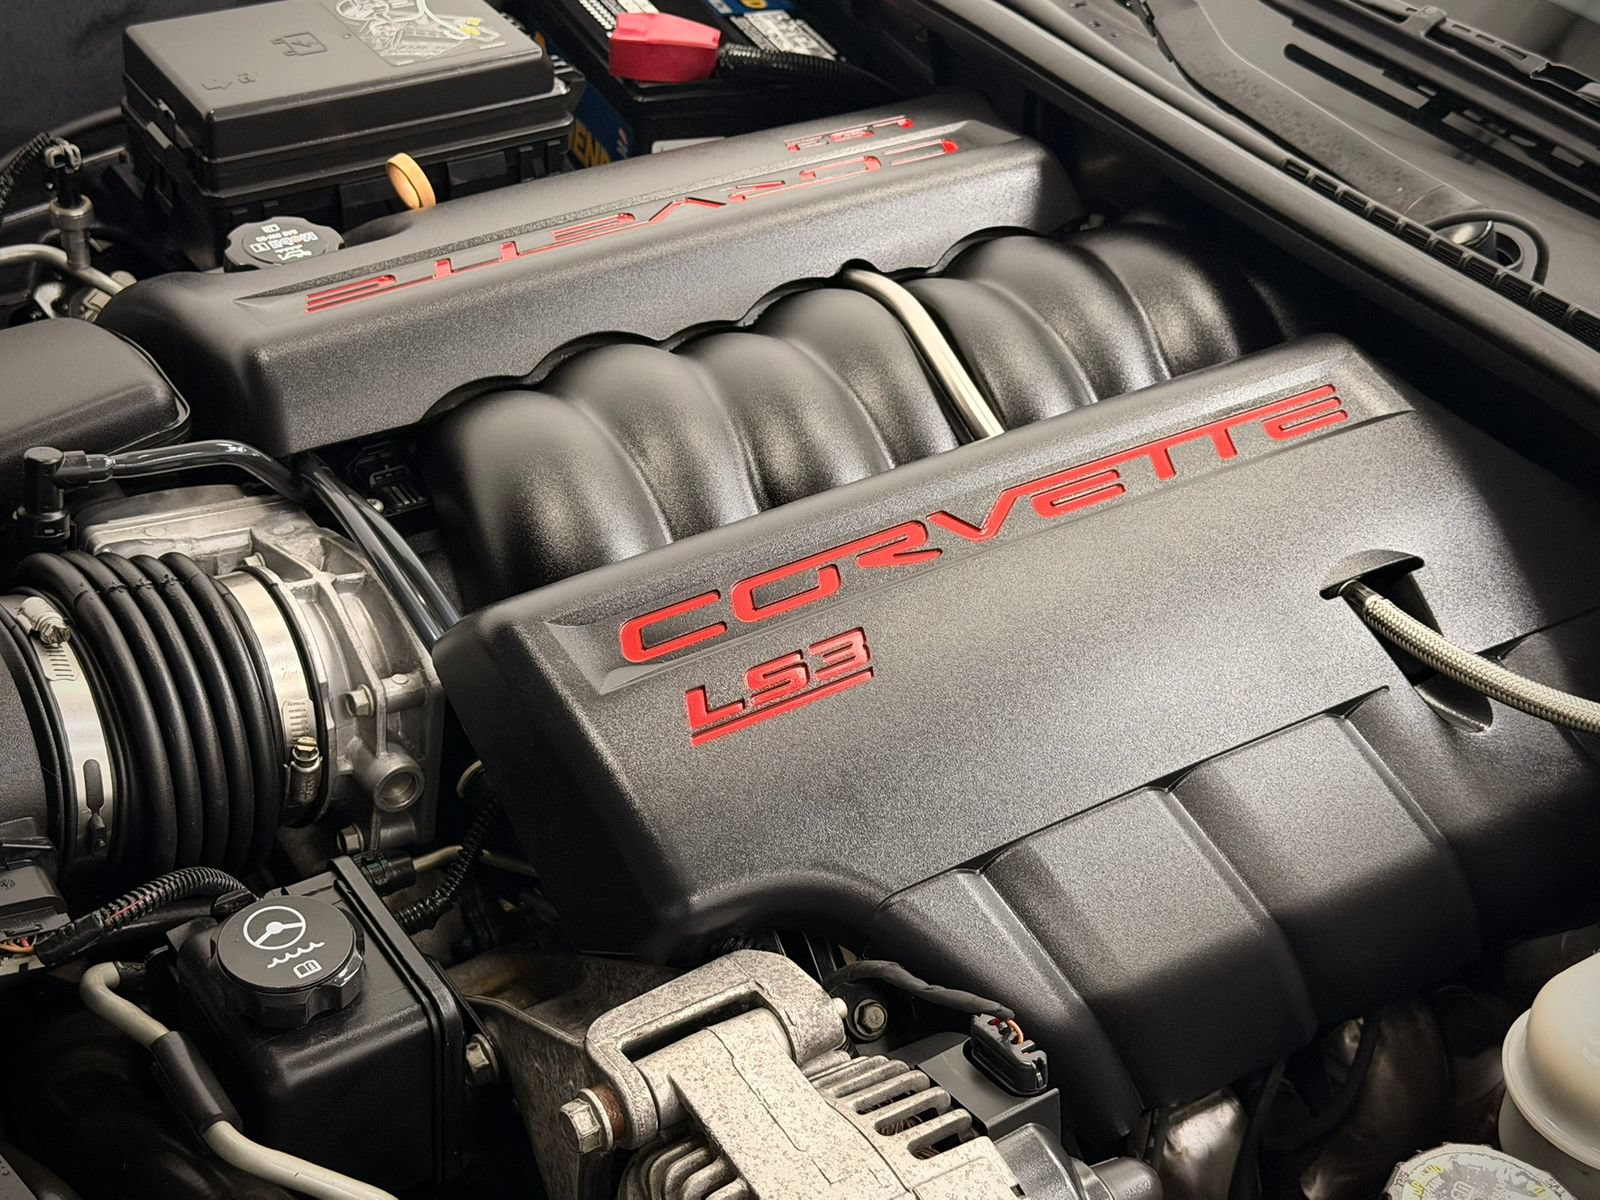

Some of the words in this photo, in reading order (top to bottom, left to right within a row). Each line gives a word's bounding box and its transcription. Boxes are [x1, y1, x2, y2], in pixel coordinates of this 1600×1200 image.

[304, 138, 960, 313] CORVETTE
[619, 384, 1349, 664] CORVETTE
[684, 626, 873, 731] LS3
